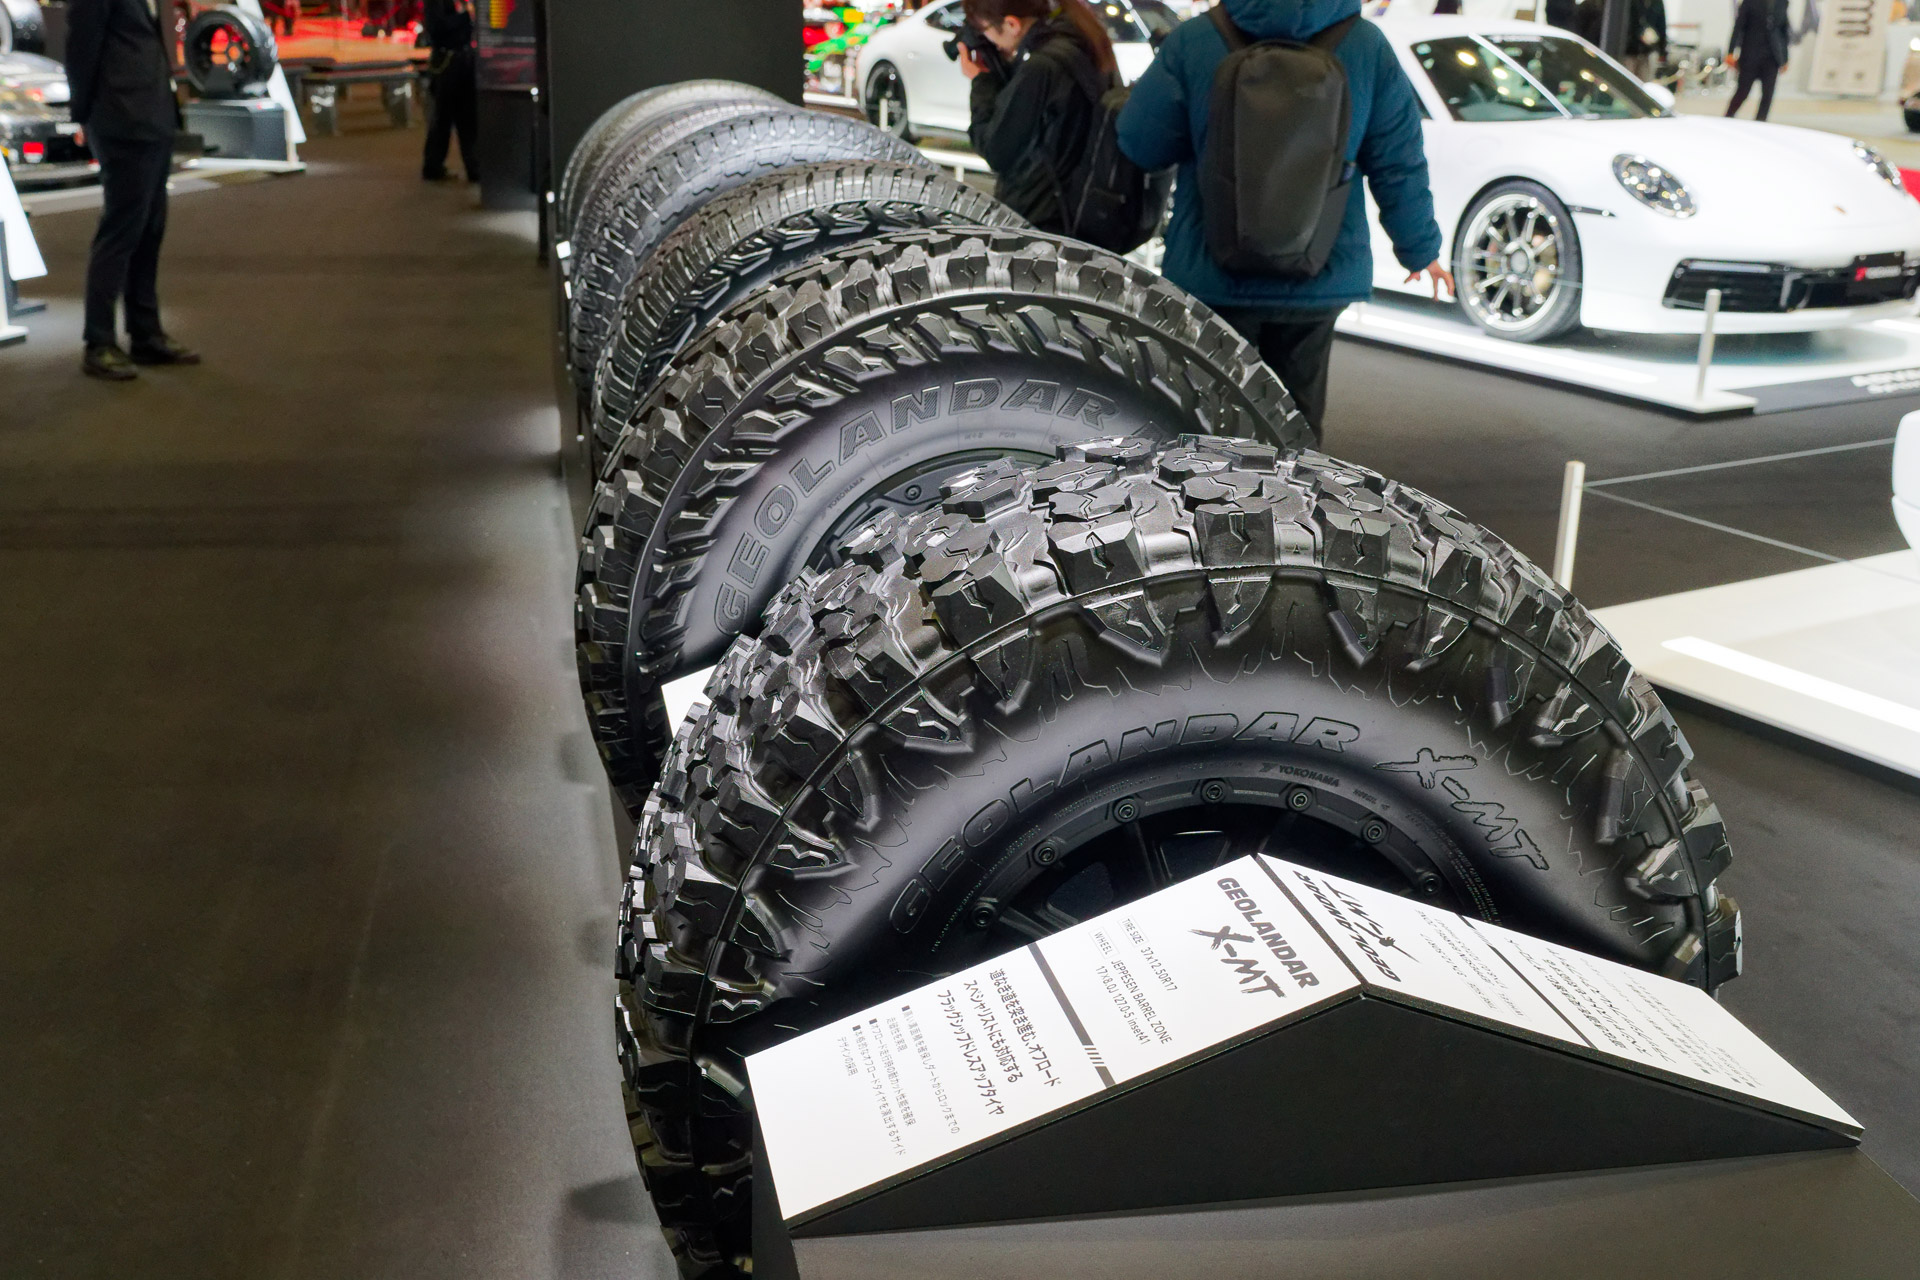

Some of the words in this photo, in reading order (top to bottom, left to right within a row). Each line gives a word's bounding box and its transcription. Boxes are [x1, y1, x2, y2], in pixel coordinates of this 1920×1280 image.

[714, 378, 1119, 637] GEOLANDAR
[827, 477, 865, 510] YOKOHAMA
[888, 711, 1361, 934] GEOLANDAR
[1372, 747, 1550, 871] X-MT
[1278, 764, 1341, 788] YOKOHAMA
[1121, 917, 1136, 933] TIRE
[1129, 930, 1145, 945] SIZE
[1140, 946, 1178, 991] 37x12.50R17
[1189, 925, 1286, 998] X-MT
[1216, 877, 1320, 989] GEOLANDAR
[1292, 870, 1402, 983] GEOLANDAR
[963, 979, 1024, 1083] スペシャリストにも対応する
[989, 968, 1062, 1087] 道なき道を突き進む、オフロード
[1094, 931, 1113, 956] WHEEL
[1110, 959, 1140, 994] JEPPESEN
[1132, 992, 1157, 1022] BARREL
[1150, 1020, 1173, 1045] ZONE
[1127, 1017, 1151, 1045] inset41
[937, 989, 1005, 1115] フラッグシップドレスアップタイヤ
